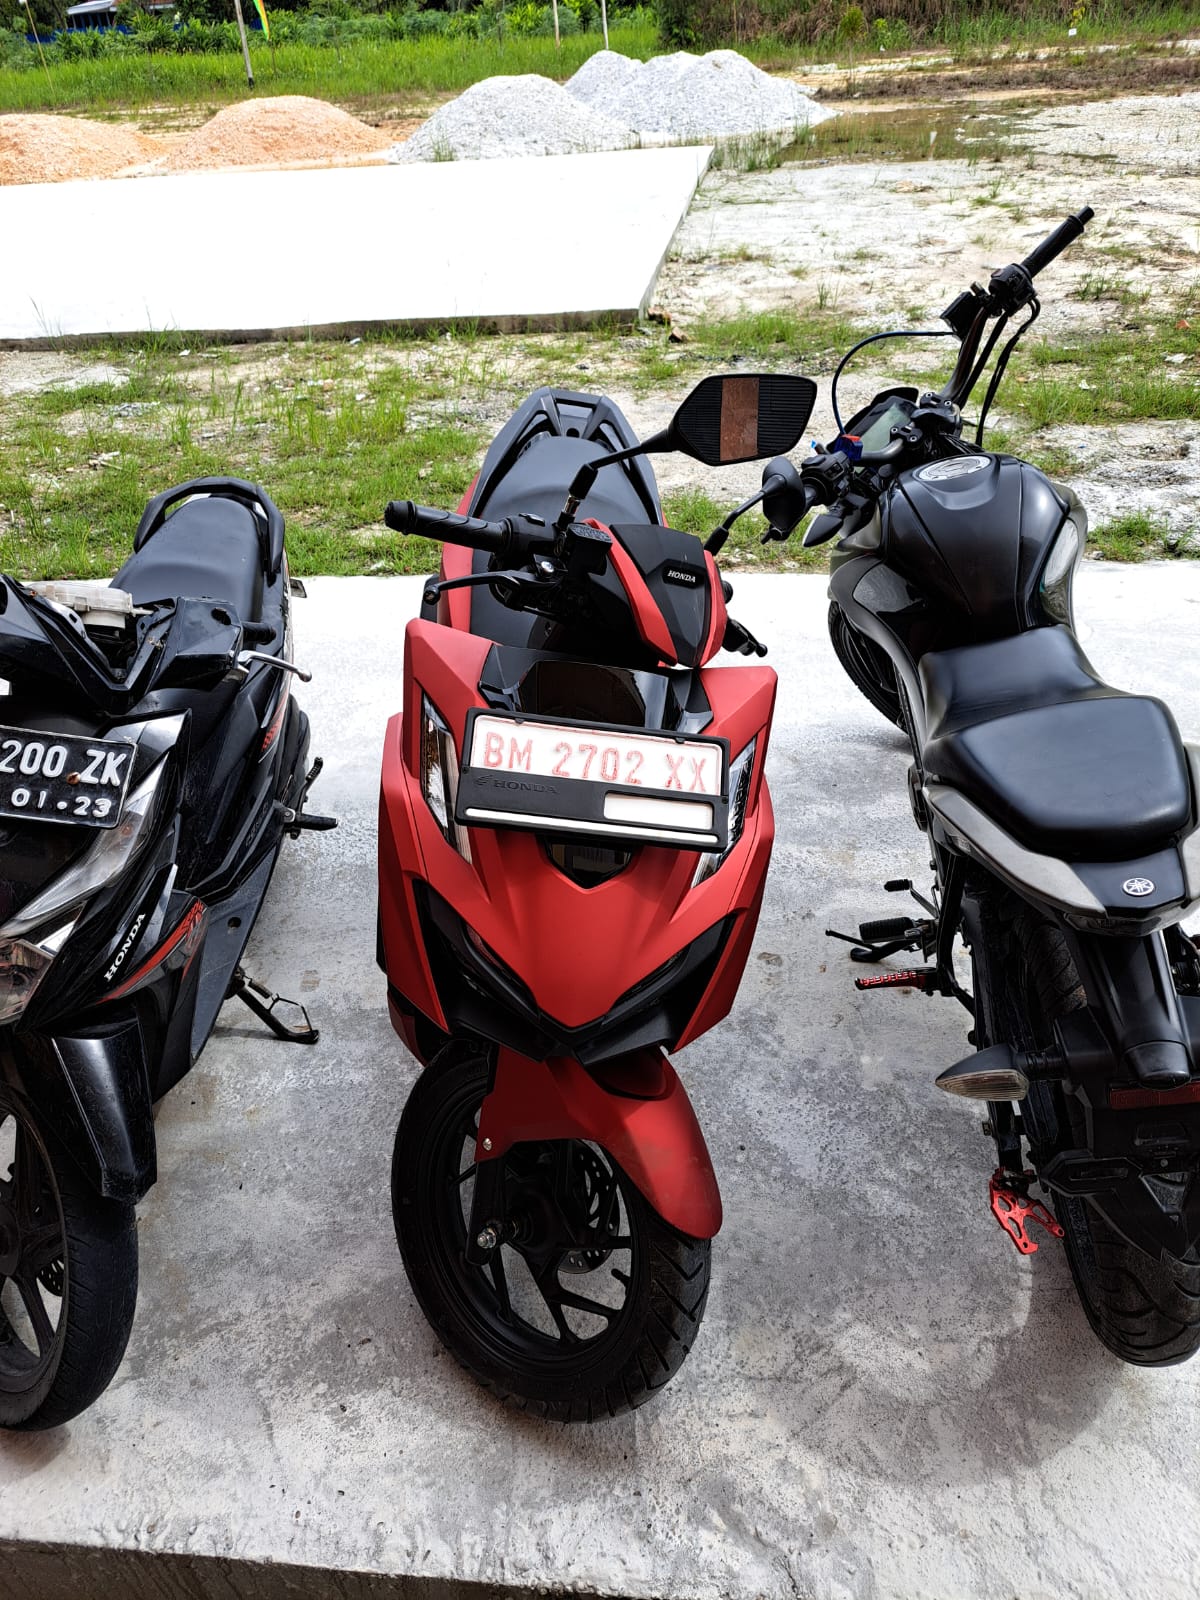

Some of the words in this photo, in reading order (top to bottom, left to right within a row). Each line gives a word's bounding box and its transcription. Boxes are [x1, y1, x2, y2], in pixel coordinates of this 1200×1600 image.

[667, 569, 696, 583] HONDA
[0, 740, 68, 778] 200
[80, 749, 127, 787] ZK
[483, 731, 533, 773] BM
[551, 741, 645, 785] 2702
[664, 753, 707, 792] XX
[494, 779, 560, 794] HONDA
[104, 913, 146, 982] HONDA
